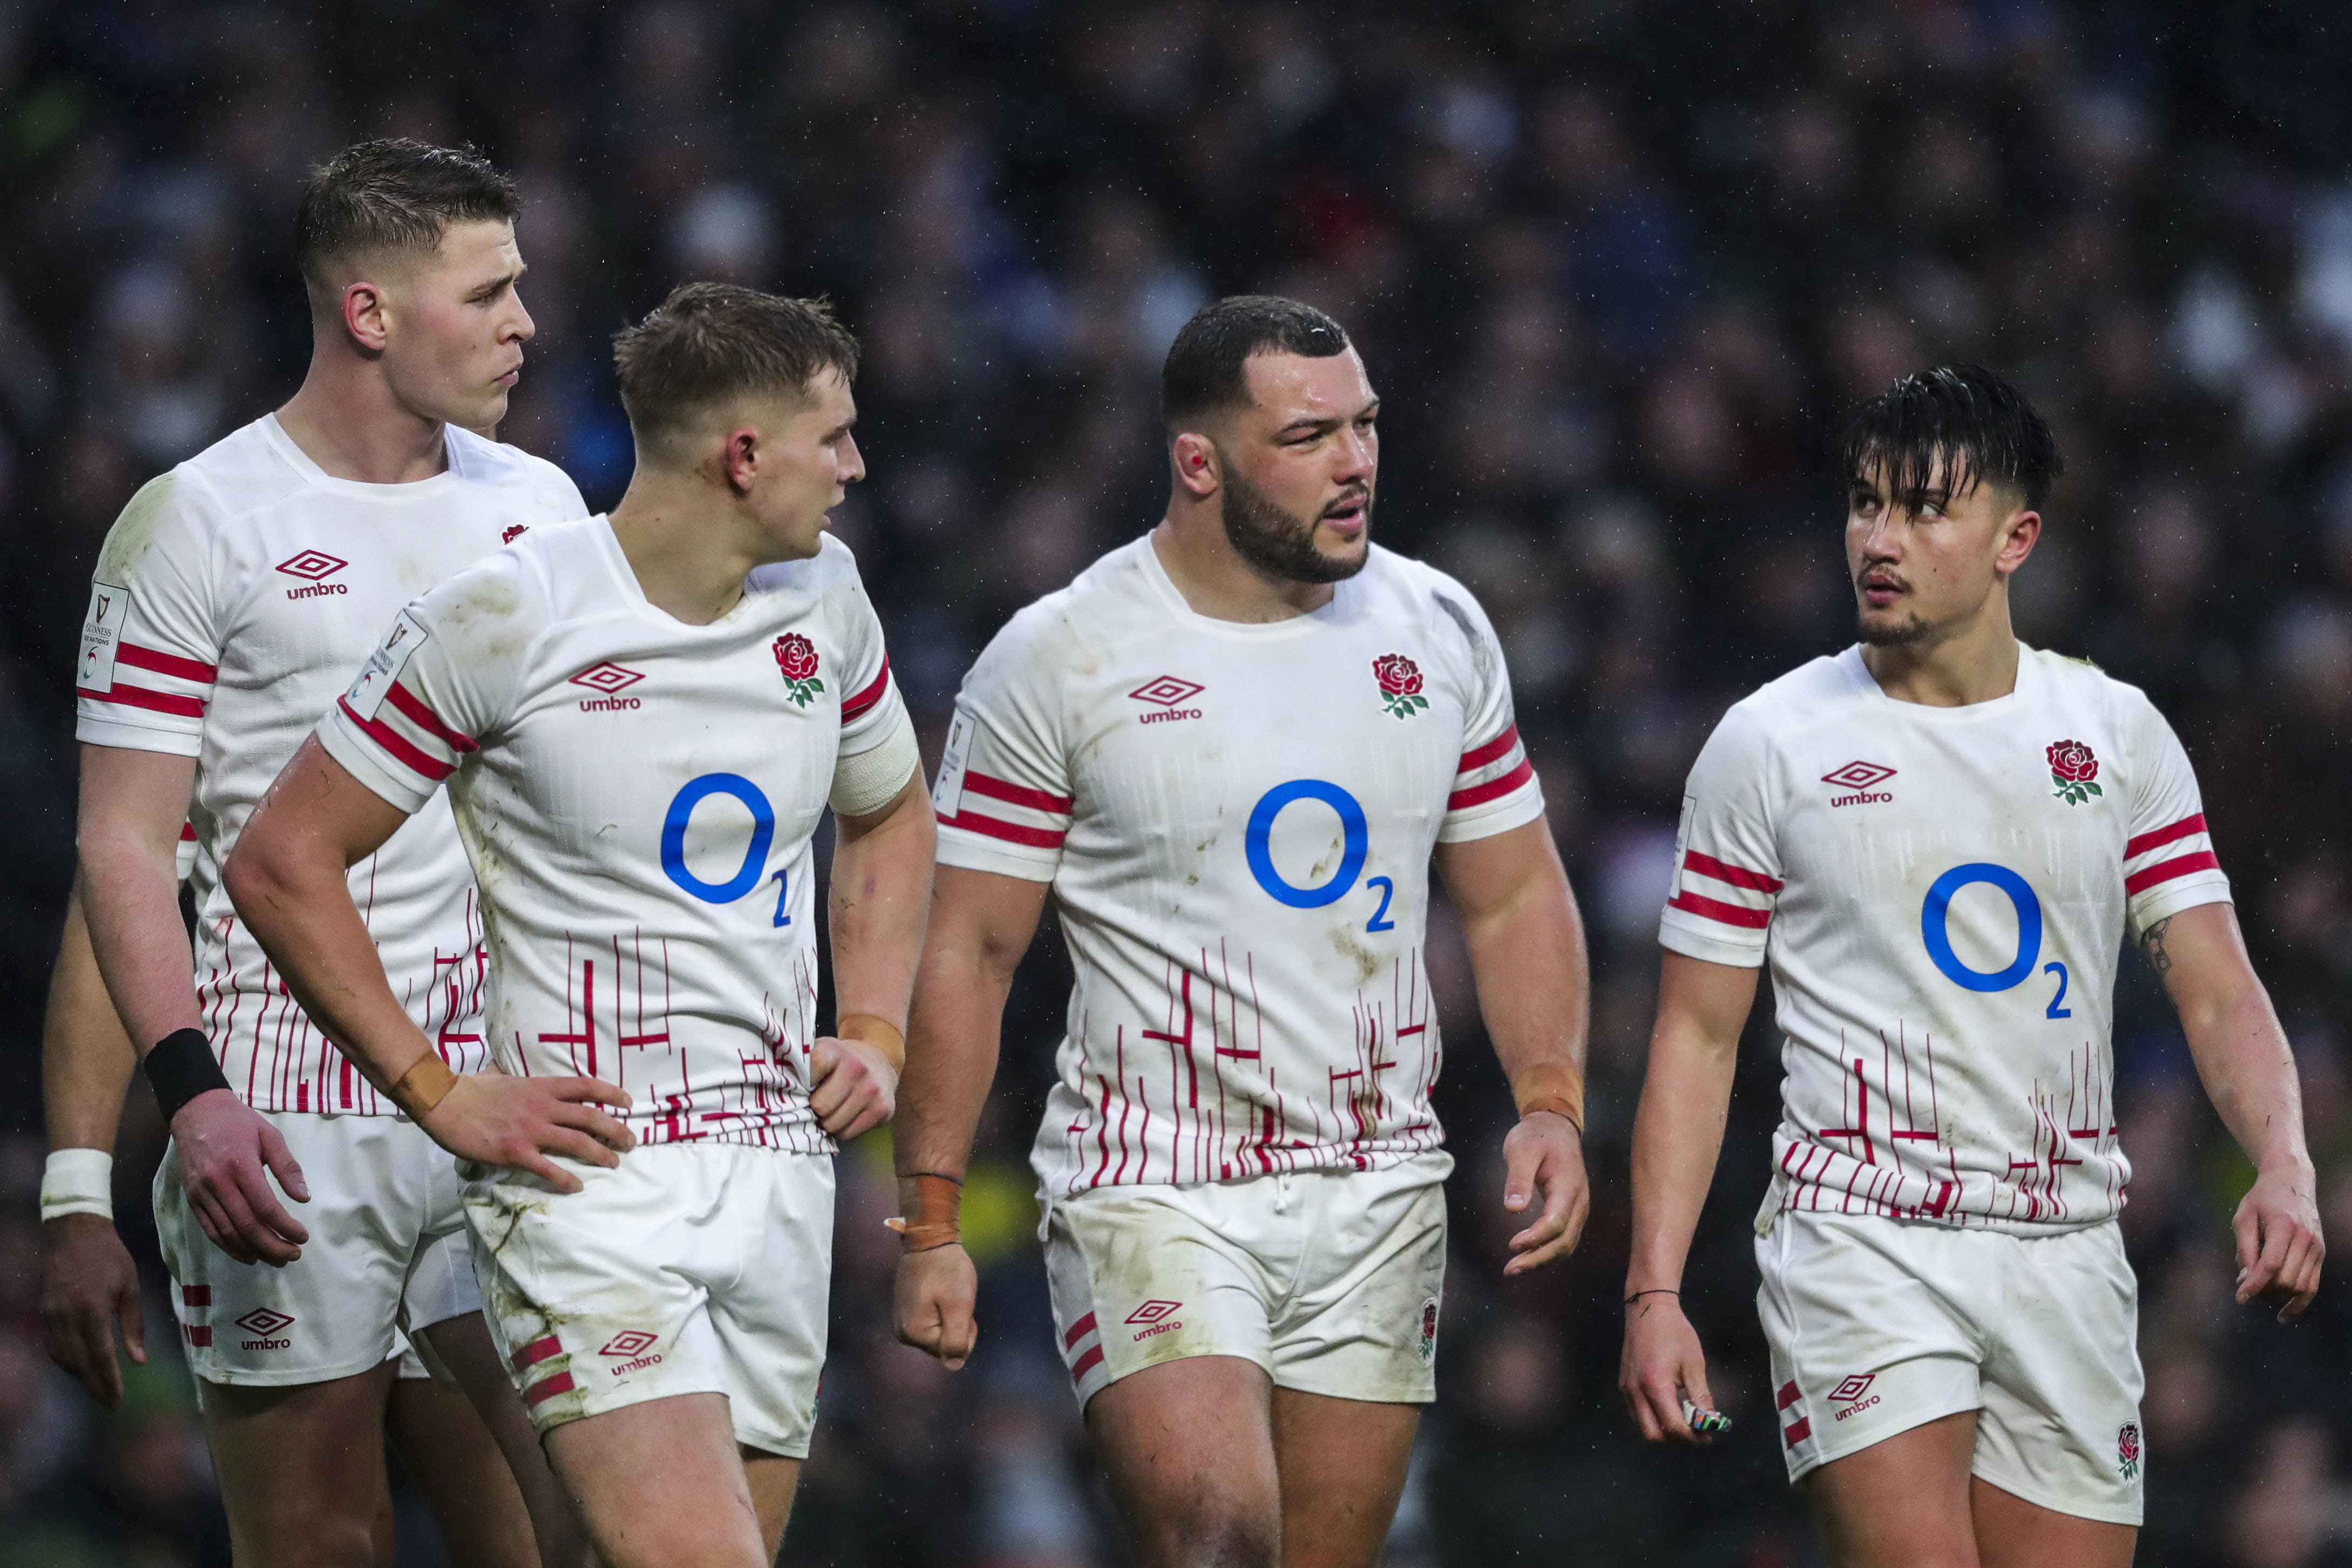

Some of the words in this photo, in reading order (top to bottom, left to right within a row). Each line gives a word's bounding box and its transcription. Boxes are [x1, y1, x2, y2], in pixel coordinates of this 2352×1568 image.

[287, 582, 348, 600] umbro
[86, 623, 112, 637] GUINNESS
[580, 696, 641, 711] umbro
[1140, 708, 1202, 724] umbro
[1831, 791, 1893, 807] umbro
[660, 772, 791, 928] O2
[1245, 778, 1395, 934] O2
[1921, 862, 2072, 1020] O2
[1133, 1321, 1183, 1342] umbro
[241, 1338, 291, 1350] umbro
[611, 1354, 662, 1376] umbro
[1835, 1395, 1881, 1421] umbro
